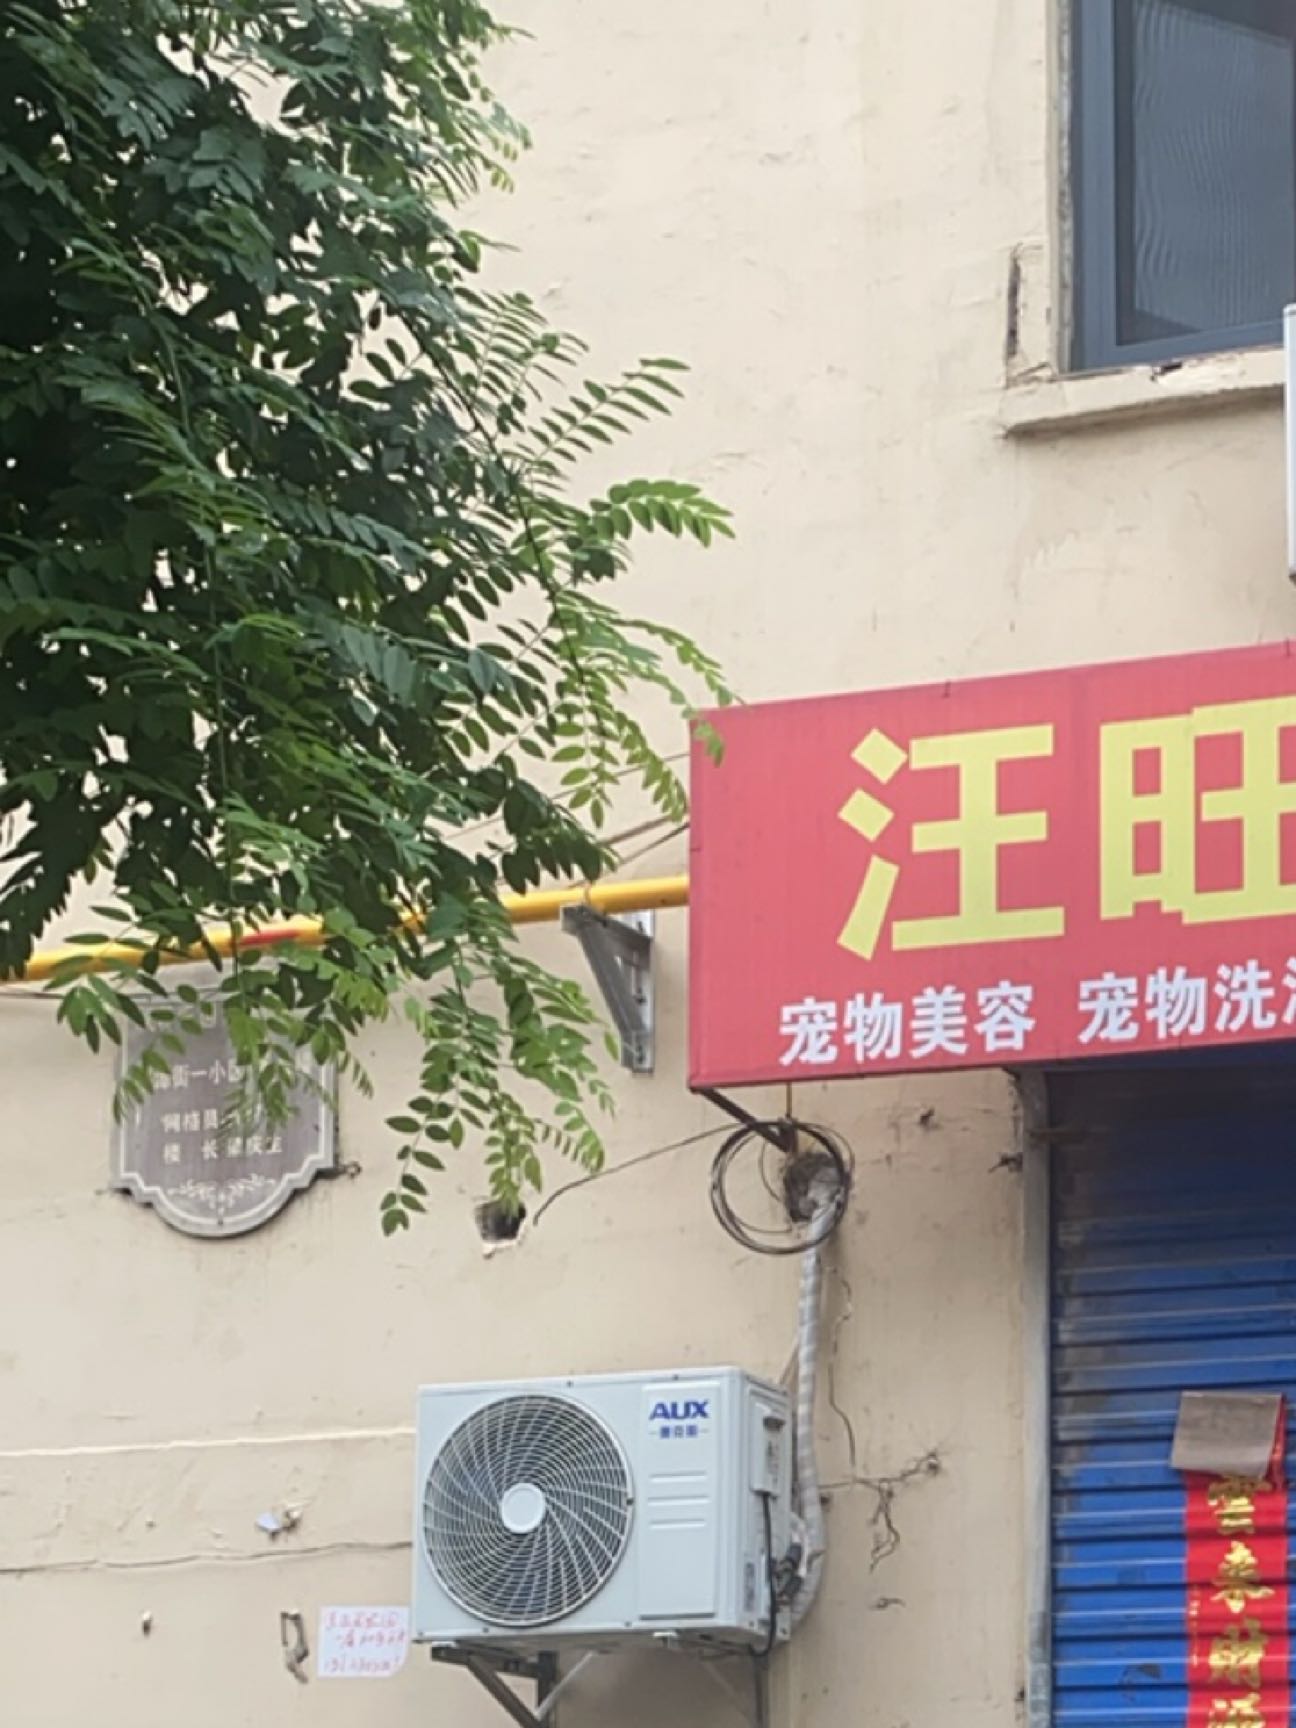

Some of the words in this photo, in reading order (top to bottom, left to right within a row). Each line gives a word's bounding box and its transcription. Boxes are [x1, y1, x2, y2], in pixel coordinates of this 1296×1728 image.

[779, 981, 1035, 1066] 宠物美容
[648, 1400, 709, 1420] AUX
